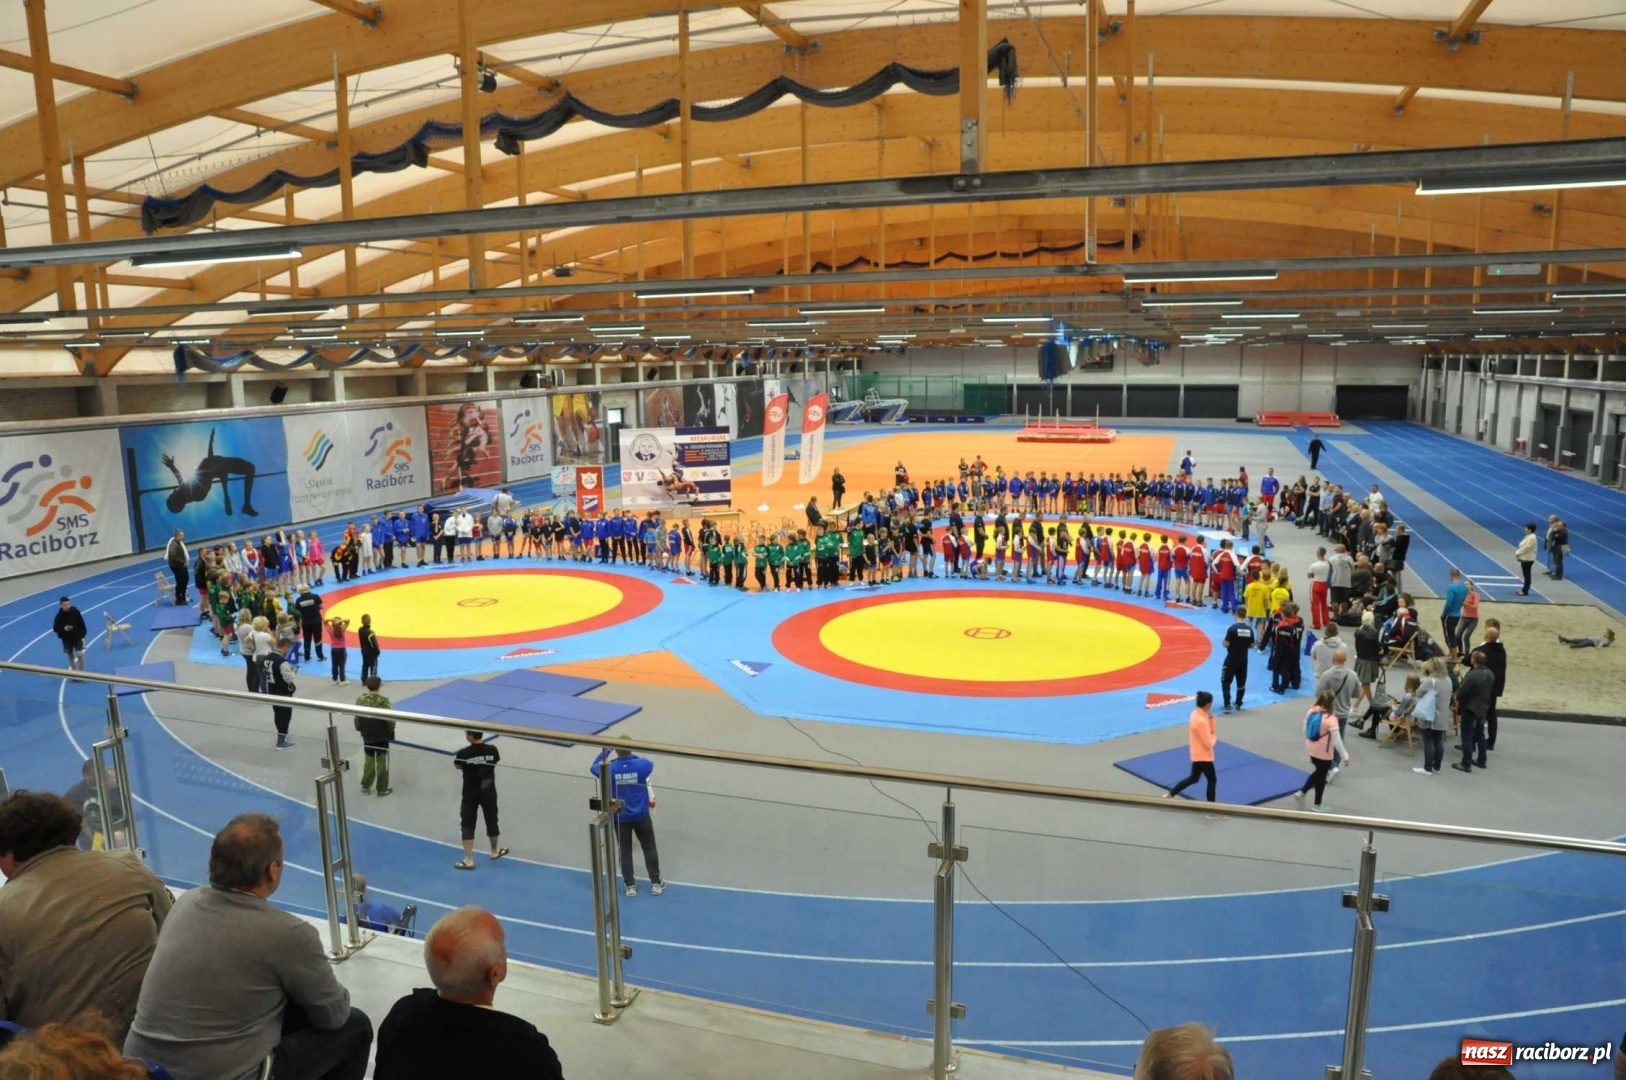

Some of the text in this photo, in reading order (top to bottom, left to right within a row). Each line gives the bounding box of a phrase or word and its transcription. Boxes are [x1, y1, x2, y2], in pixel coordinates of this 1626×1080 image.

[393, 461, 410, 473] SMS
[365, 471, 414, 491] Racibórz
[56, 513, 90, 531] SMS
[0, 529, 100, 561] Racibórz
